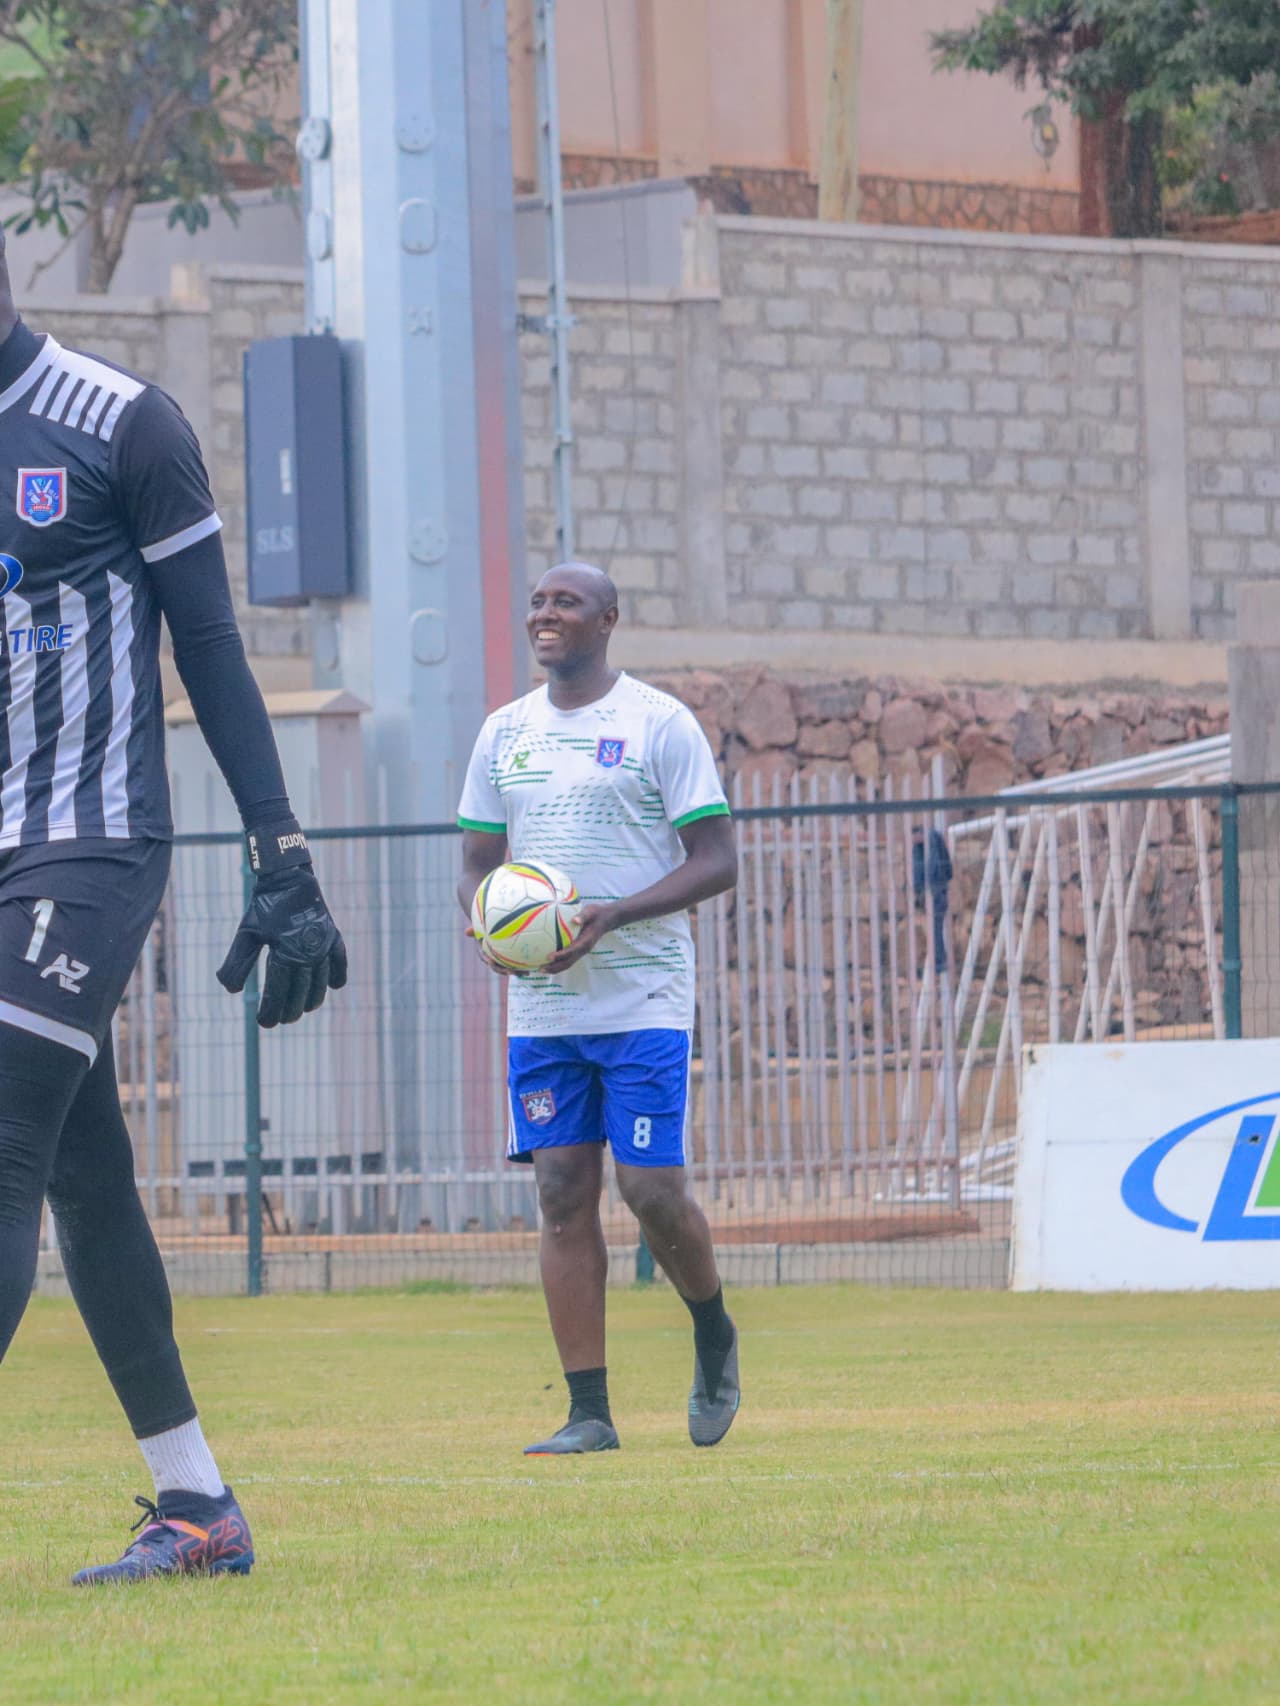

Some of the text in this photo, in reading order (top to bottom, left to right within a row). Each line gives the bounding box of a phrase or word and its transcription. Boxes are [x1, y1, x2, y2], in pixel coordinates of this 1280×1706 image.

[256, 525, 295, 554] SLS
[9, 623, 74, 653] TIRE
[24, 898, 54, 963] 1
[633, 1116, 652, 1149] 8
